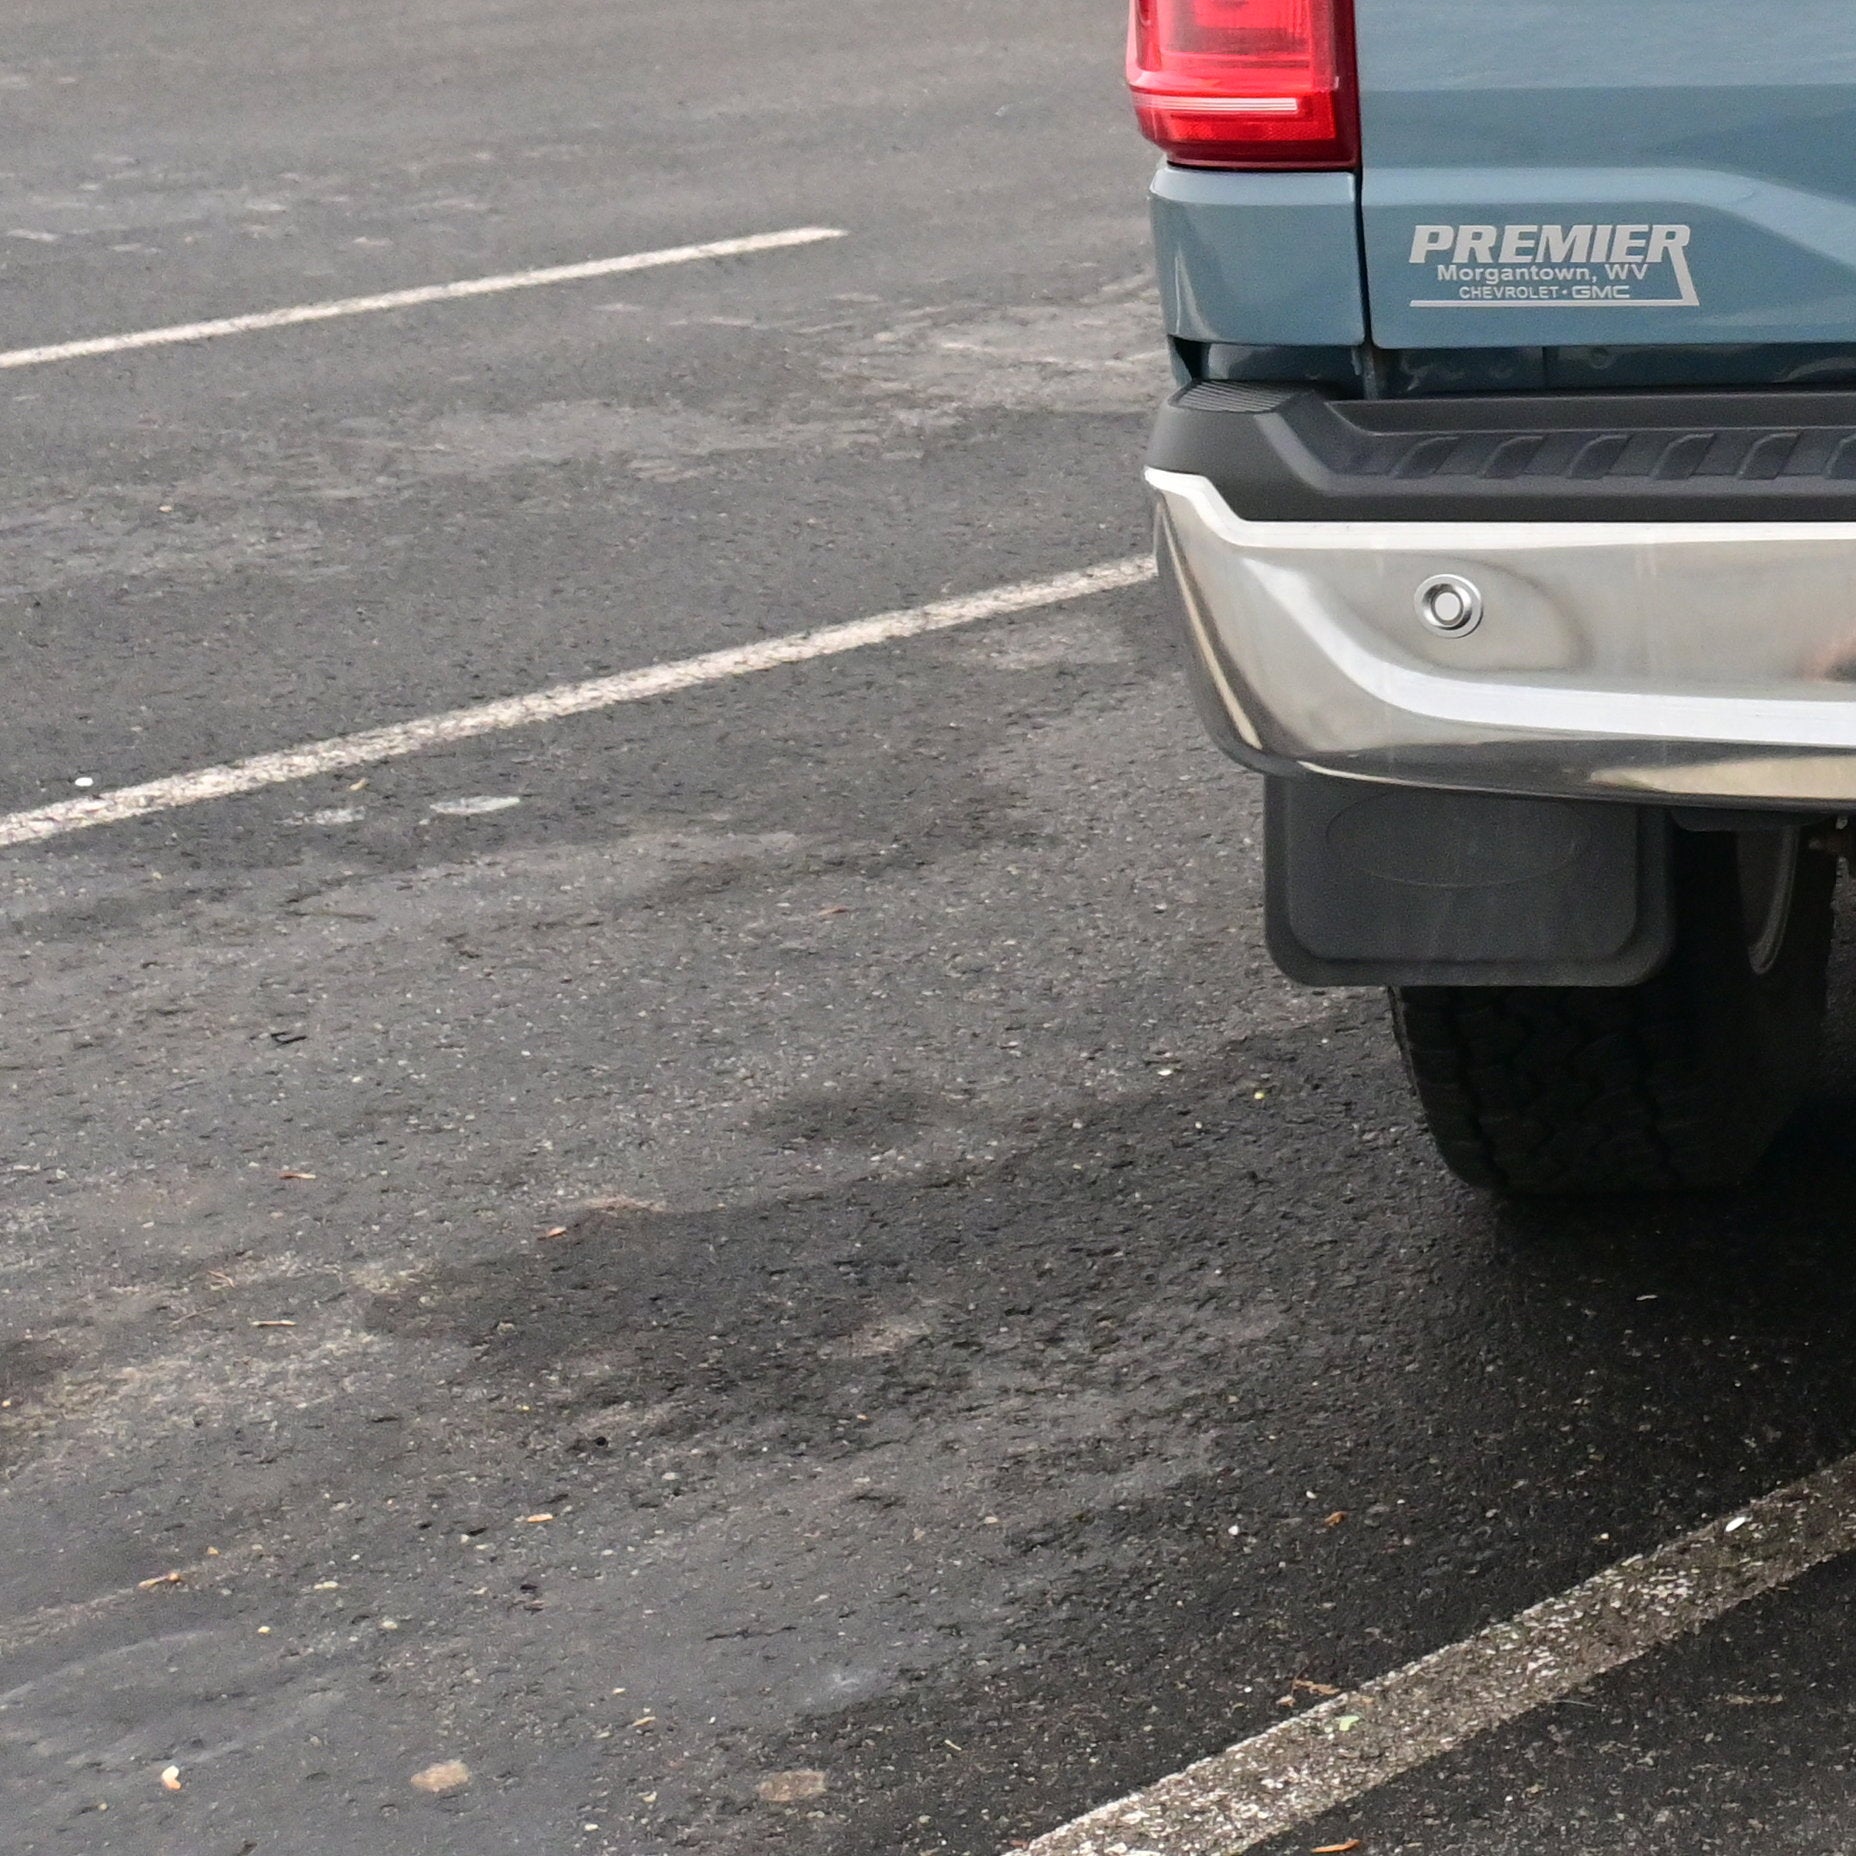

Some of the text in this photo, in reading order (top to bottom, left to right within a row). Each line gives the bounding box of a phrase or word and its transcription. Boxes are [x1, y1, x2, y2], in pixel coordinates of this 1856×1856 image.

[1409, 224, 1691, 264] PREMIER
[1437, 263, 1650, 285] Morgantown, WV
[1459, 285, 1630, 300] CHEVROLET GMC
